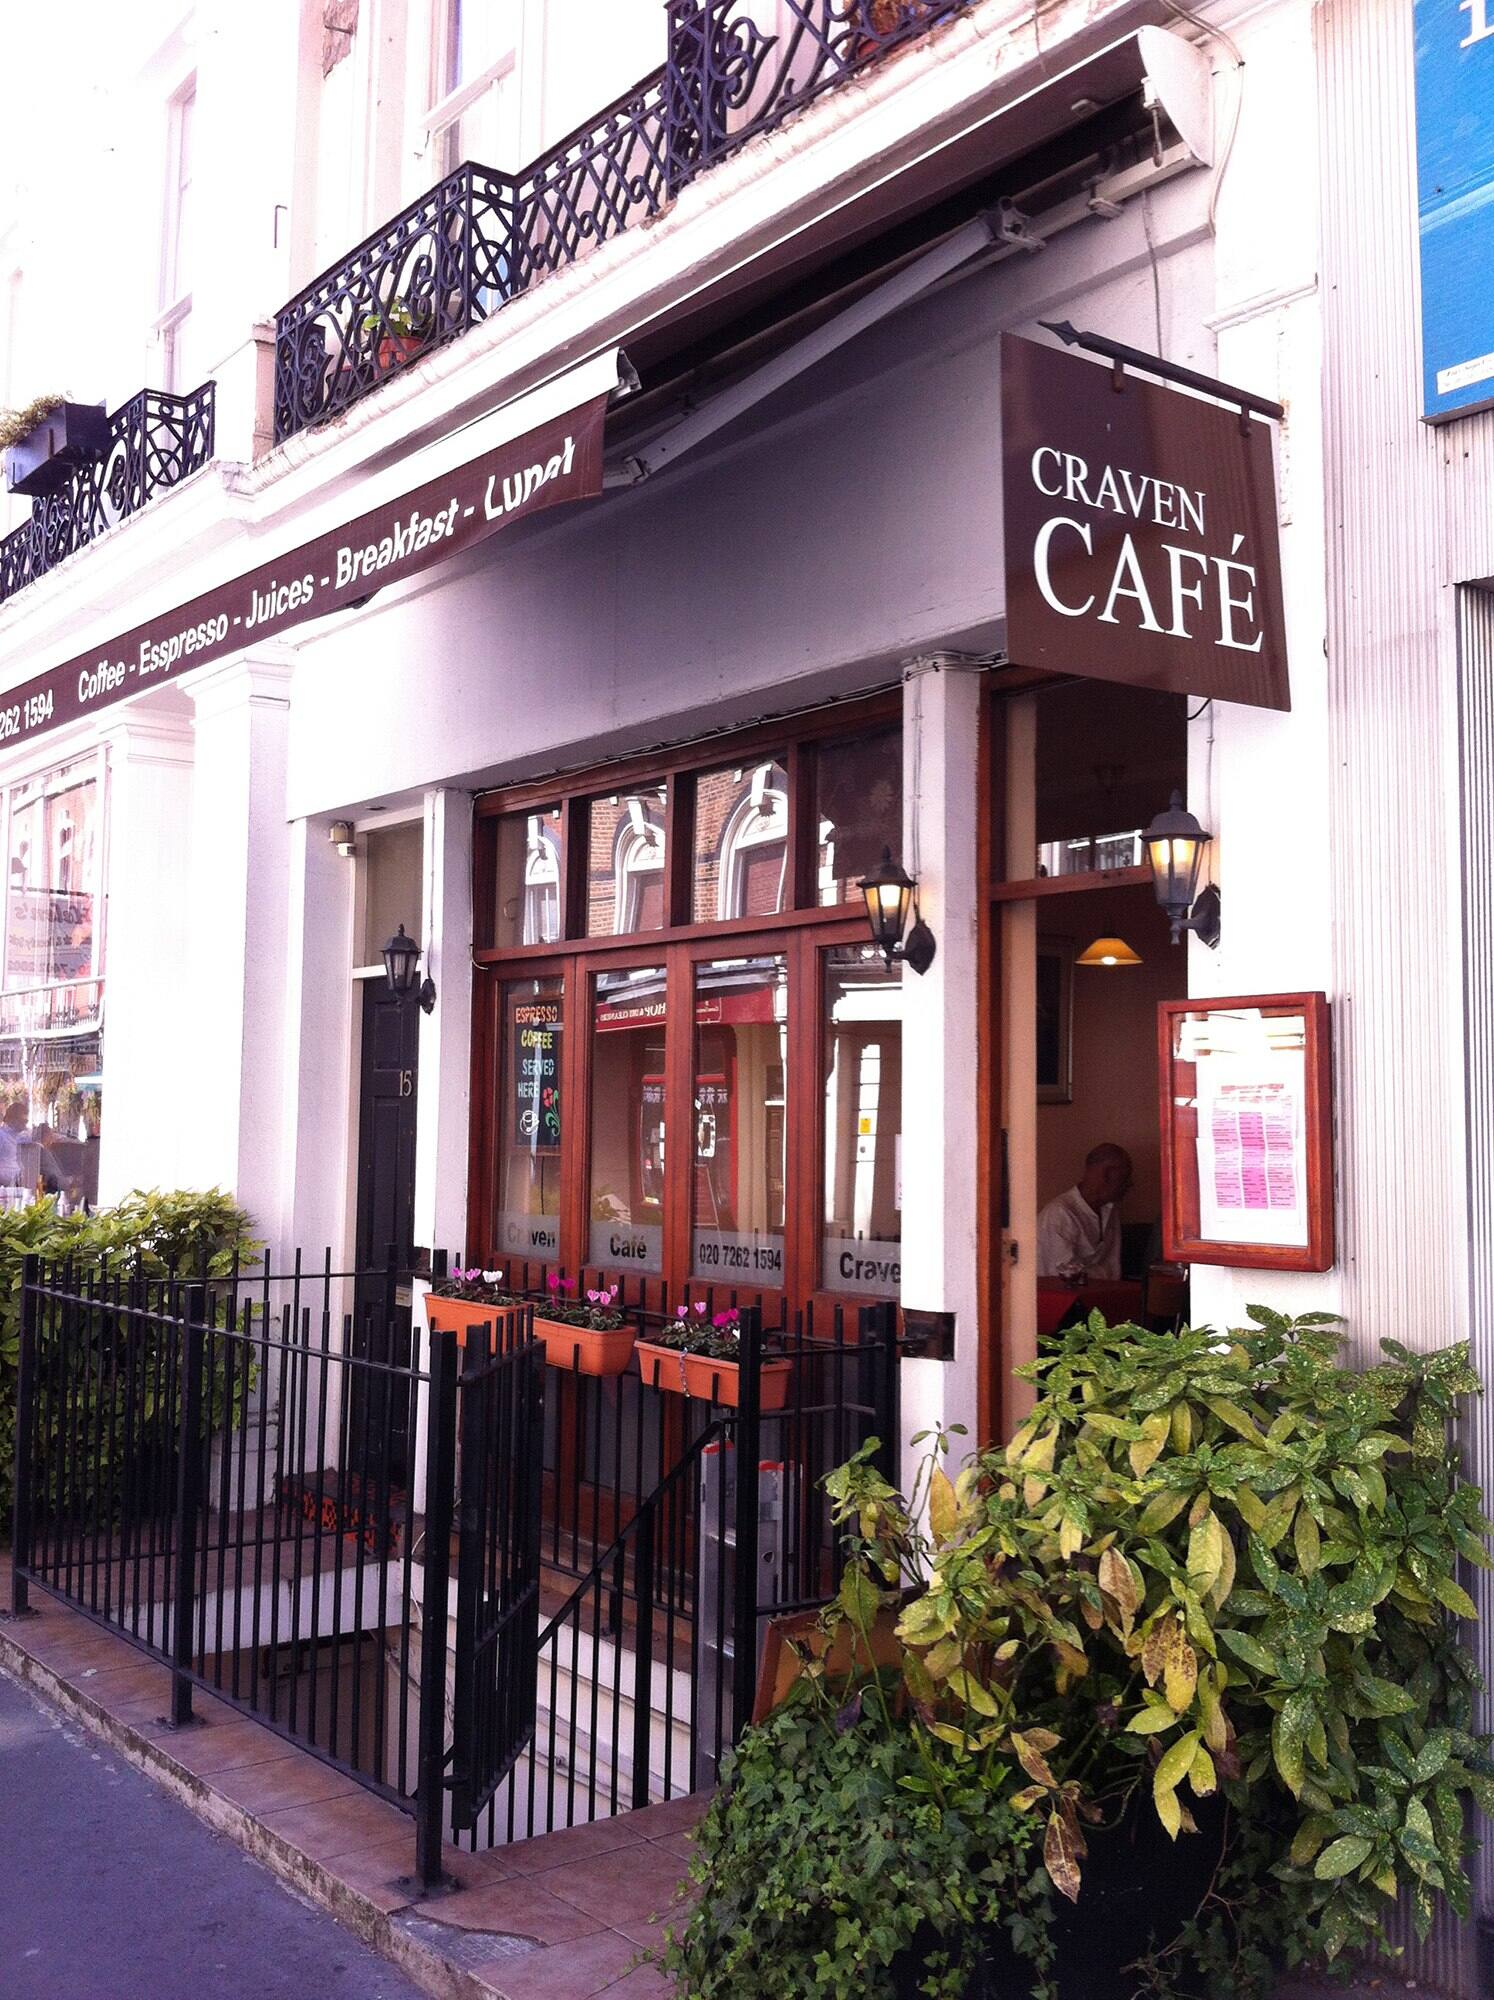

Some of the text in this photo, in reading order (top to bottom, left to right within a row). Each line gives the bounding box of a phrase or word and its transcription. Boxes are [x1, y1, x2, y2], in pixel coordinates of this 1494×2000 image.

[1031, 446, 1206, 536] CRAVEN
[1033, 516, 1264, 653] CAFÉ
[24, 689, 55, 730] 1594
[78, 659, 126, 703] Coffee
[139, 613, 229, 676] Esspresso
[245, 574, 315, 629] Juices
[335, 497, 460, 590] Breakfast
[515, 1006, 558, 1024] ESPRESSO
[521, 1029, 553, 1049] COFFEE
[522, 1058, 555, 1076] SERVED
[517, 1081, 541, 1098] HERE
[609, 1232, 647, 1260] Café
[699, 1243, 782, 1272] 020 7262 1594
